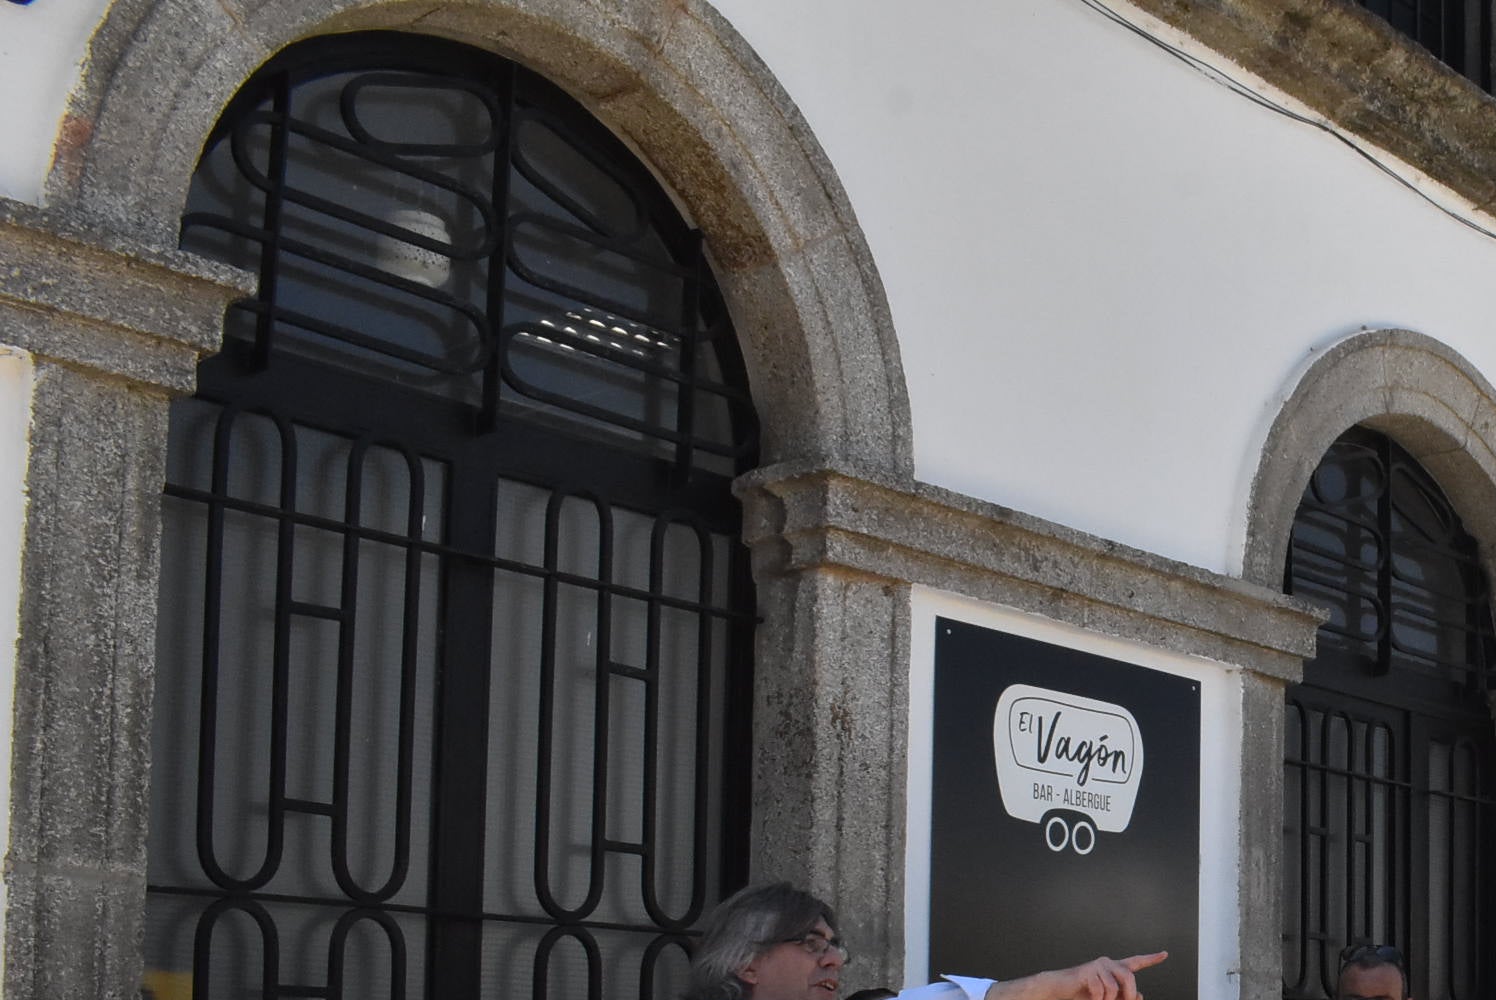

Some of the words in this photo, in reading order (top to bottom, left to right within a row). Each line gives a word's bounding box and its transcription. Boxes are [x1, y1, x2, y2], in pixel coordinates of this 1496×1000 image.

[1018, 711, 1034, 734] El
[1036, 711, 1128, 787] Vagón
[1032, 782, 1054, 802] BAR
[1063, 788, 1112, 813] ALBERGUE
